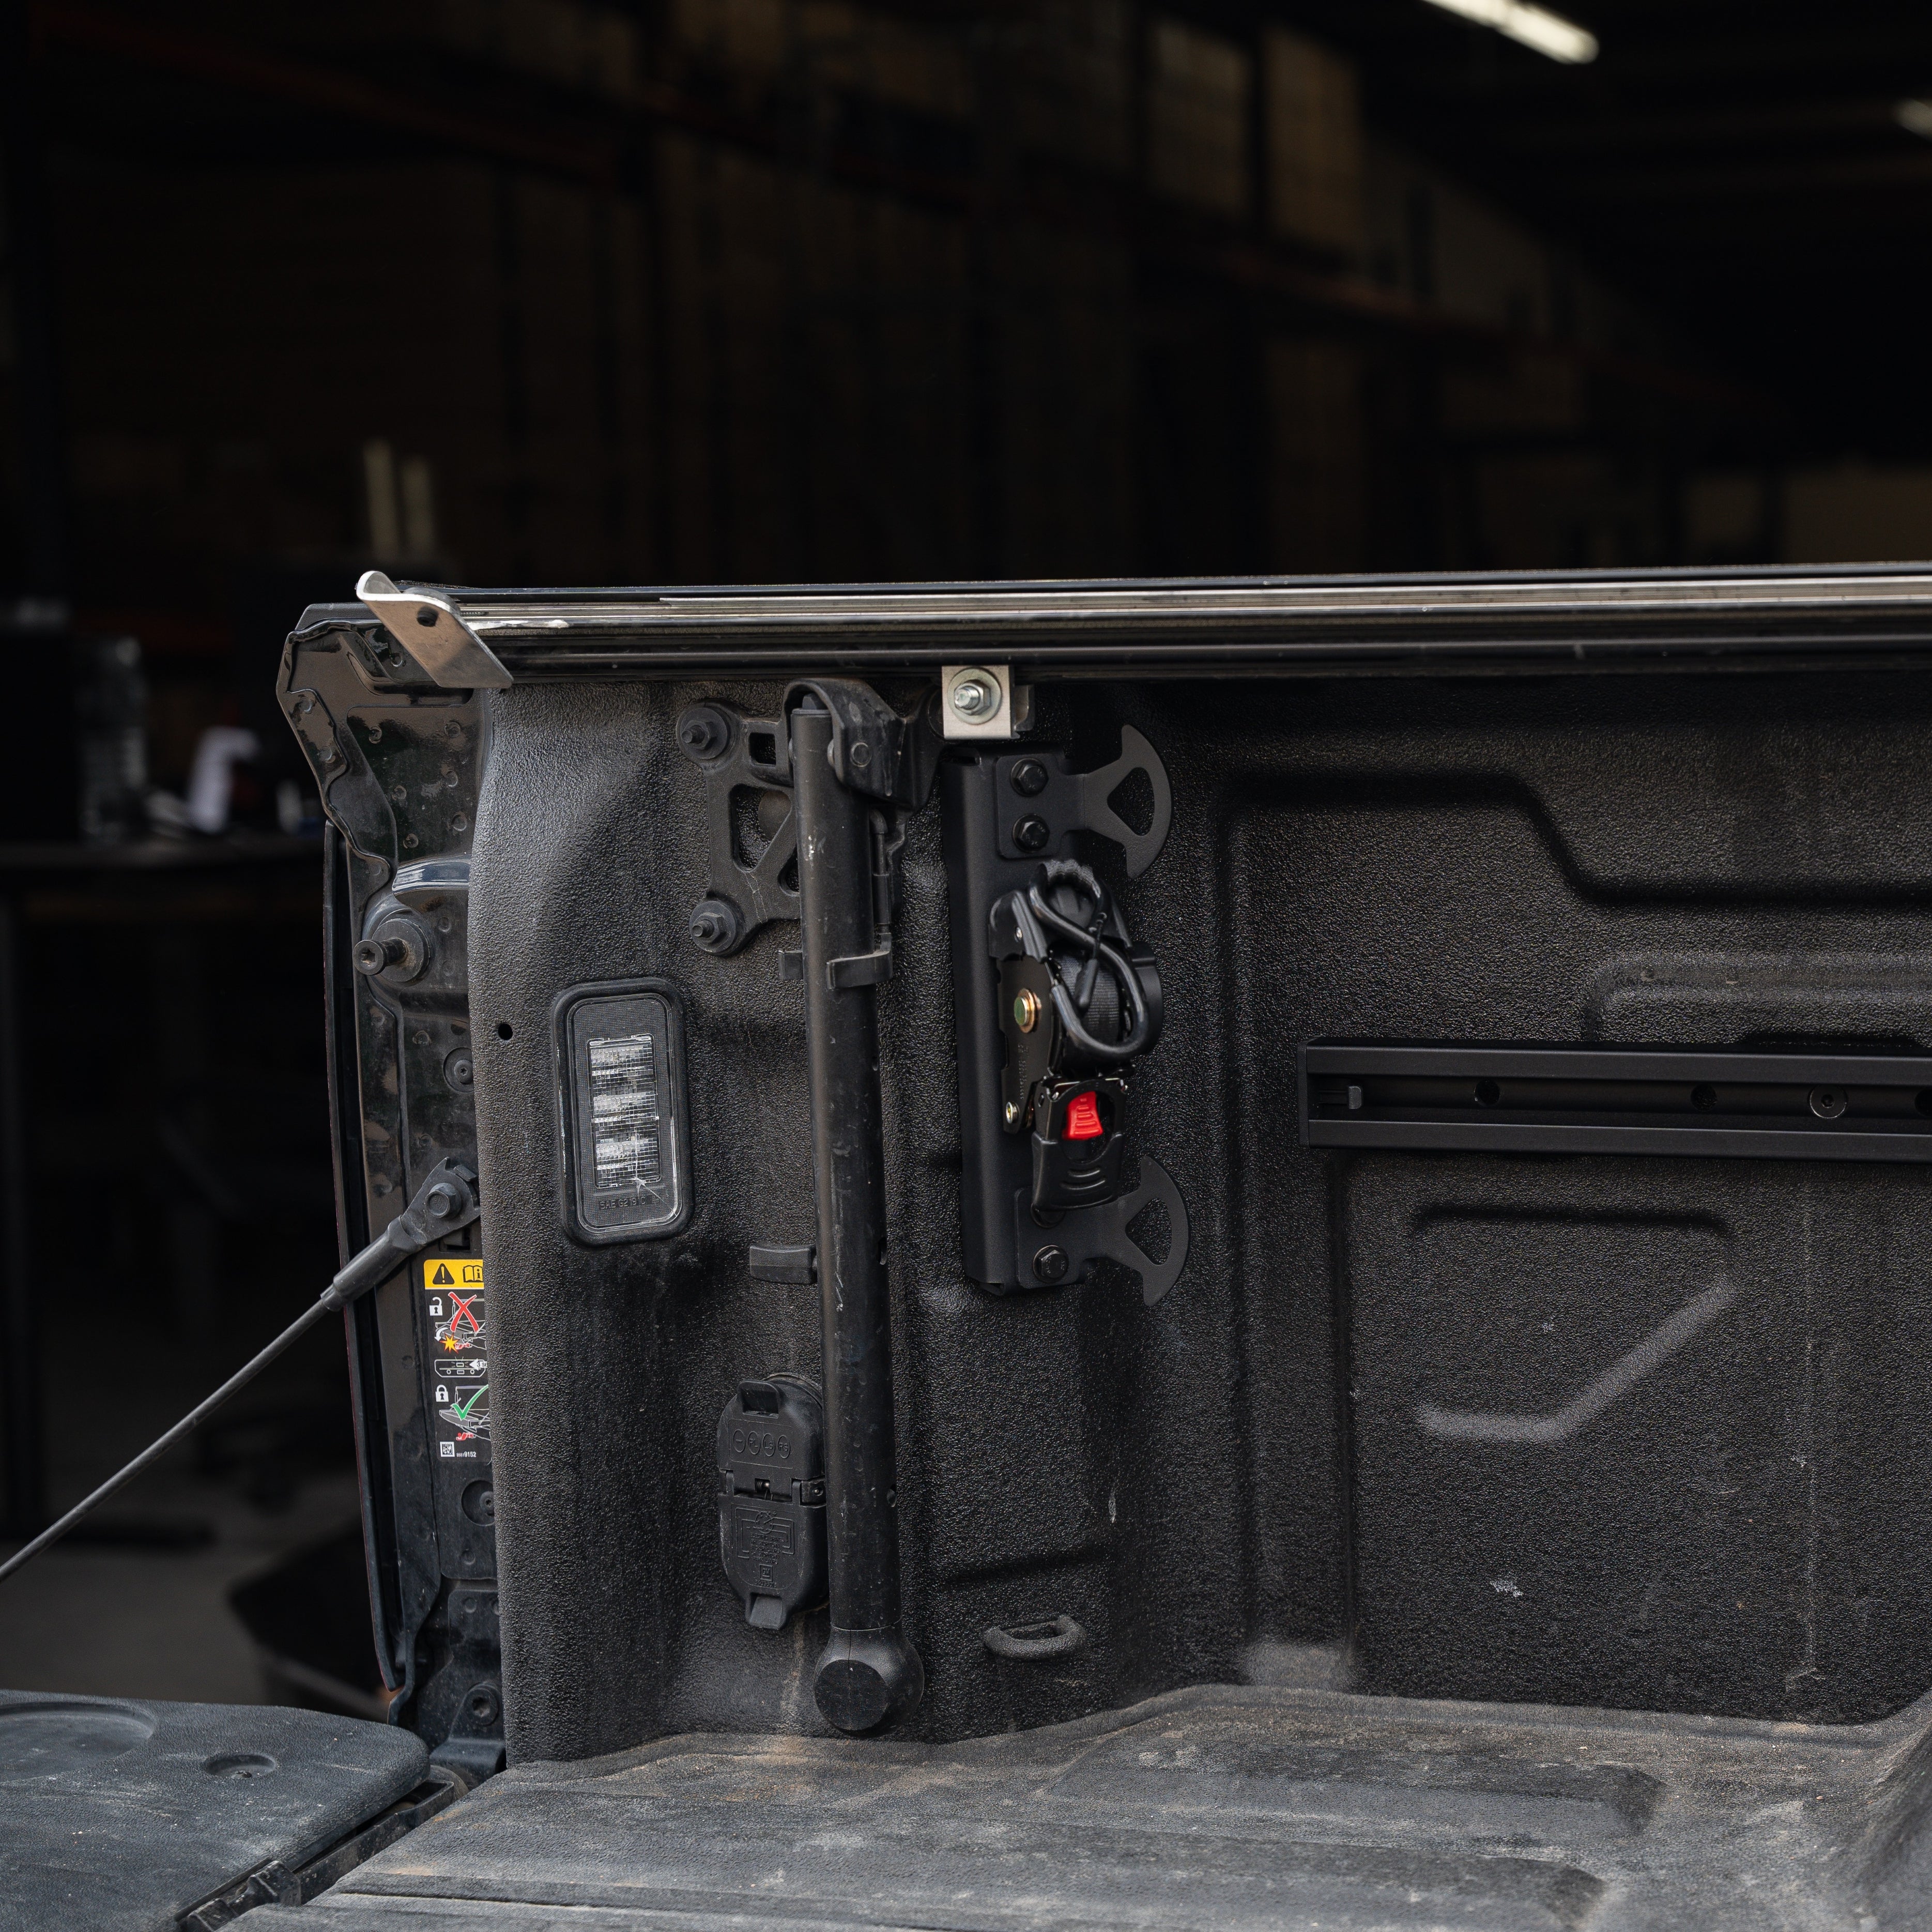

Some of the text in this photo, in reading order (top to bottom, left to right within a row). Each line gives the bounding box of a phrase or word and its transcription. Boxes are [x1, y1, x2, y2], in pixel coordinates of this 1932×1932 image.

[749, 1438, 759, 1448] PL
[764, 1440, 773, 1449] LS
[779, 1442, 789, 1451] RS
